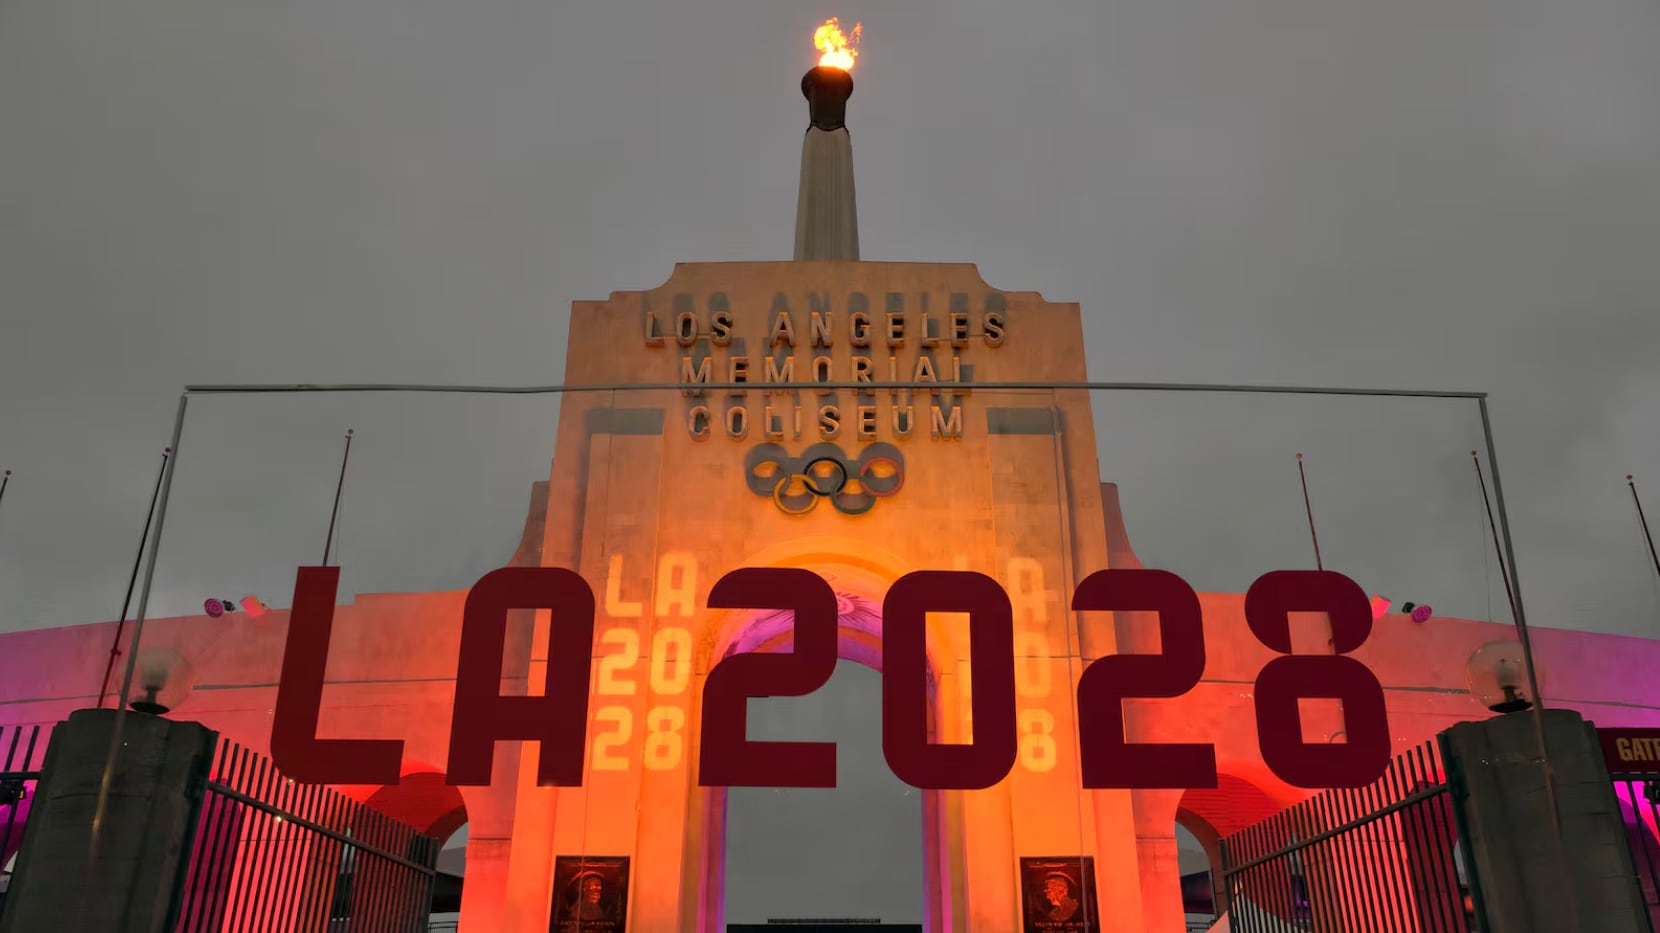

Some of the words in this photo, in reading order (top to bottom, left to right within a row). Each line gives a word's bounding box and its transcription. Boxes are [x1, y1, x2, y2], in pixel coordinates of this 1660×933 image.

[644, 311, 732, 347] LOS
[769, 311, 1006, 348] ANGELES
[681, 355, 971, 397] MEMORIAL
[688, 405, 962, 442] COLISEUM
[605, 552, 698, 617] LA
[270, 566, 595, 788] LA
[698, 567, 1391, 790] 2028
[598, 627, 693, 695] 20
[592, 705, 686, 771] 28
